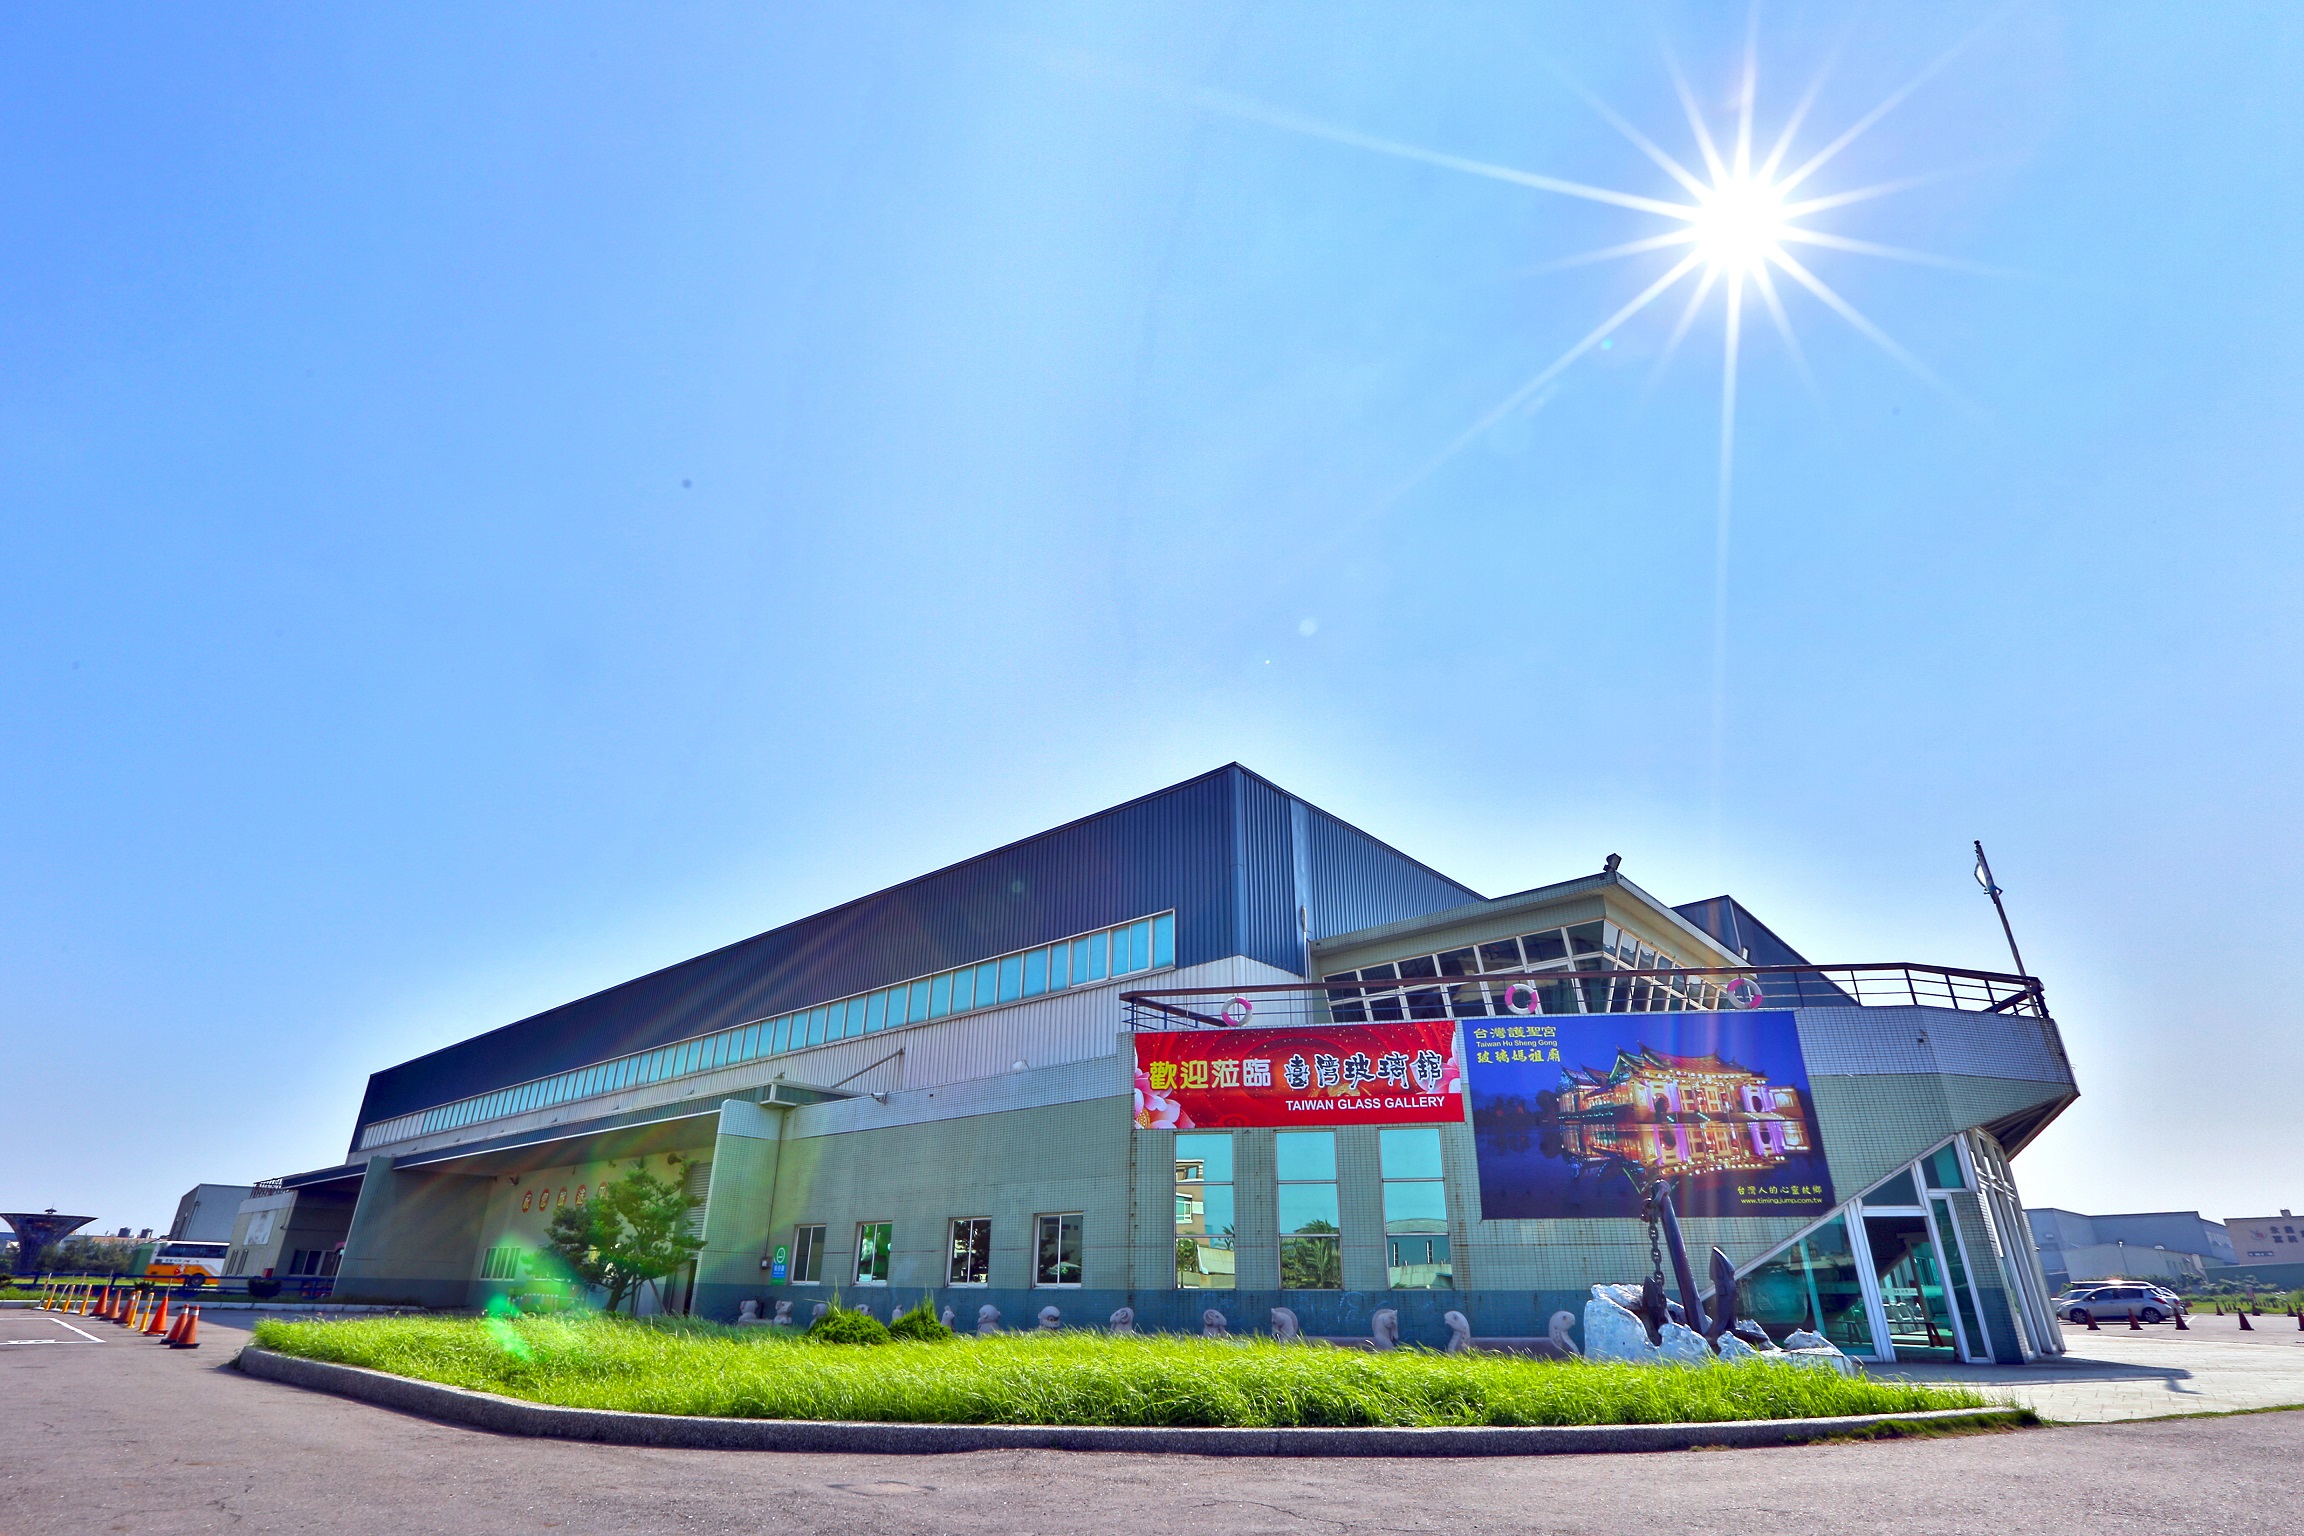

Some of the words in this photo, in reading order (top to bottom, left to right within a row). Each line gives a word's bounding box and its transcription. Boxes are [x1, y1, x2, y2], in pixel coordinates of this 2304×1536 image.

[1473, 1026, 1557, 1039] 台灣護聖宮
[1514, 1040, 1537, 1048] Sheng
[1538, 1039, 1558, 1047] Gong
[1476, 1049, 1561, 1064] 玻璃媽祖廟
[1149, 1058, 1272, 1090] 歡迎蒞臨
[1286, 1100, 1334, 1111] TAIWAN
[1337, 1098, 1381, 1109] GLASS
[1384, 1096, 1445, 1108] GALLERY
[1737, 1185, 1822, 1195] 台灣人的心靈故鄉
